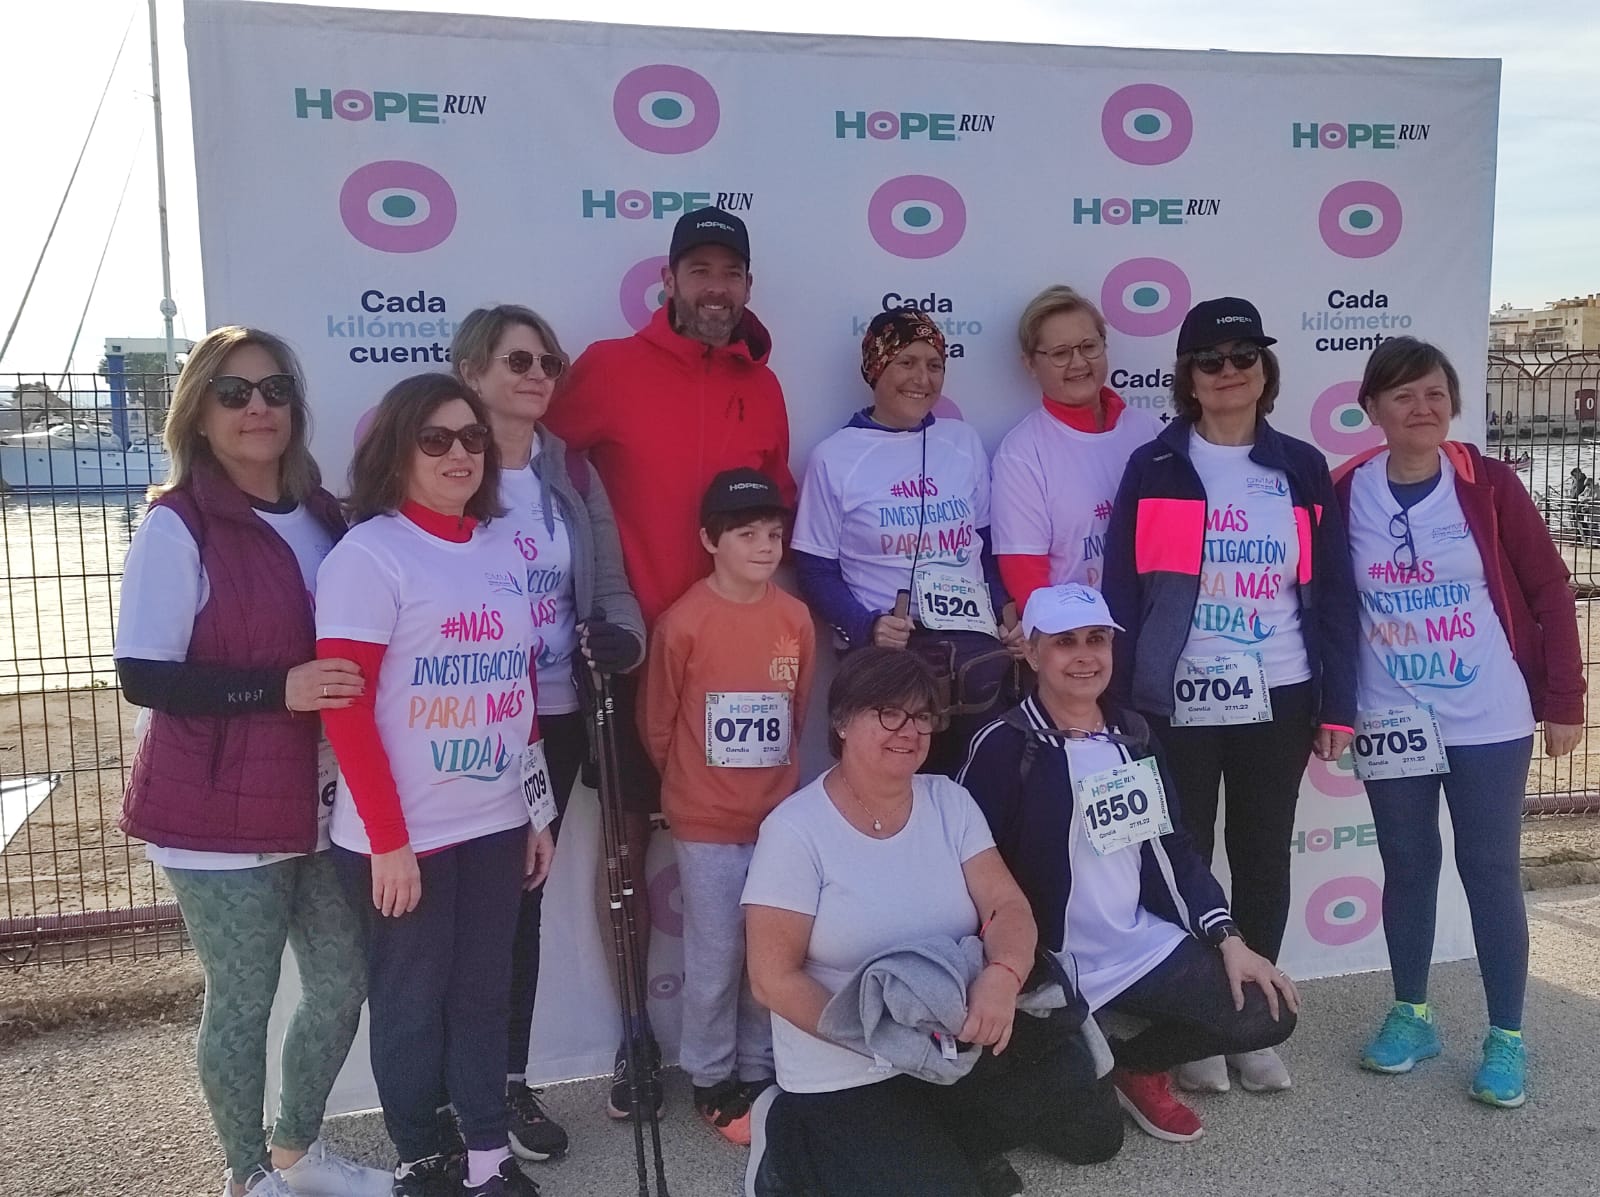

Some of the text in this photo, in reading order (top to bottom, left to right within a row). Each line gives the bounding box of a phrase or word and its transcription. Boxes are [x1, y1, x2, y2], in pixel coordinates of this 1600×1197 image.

[295, 88, 486, 124] HOPE RUN
[835, 111, 995, 141] HOPE RUN
[1292, 122, 1430, 149] HOPE RUN
[716, 192, 753, 211] RUN
[1073, 198, 1221, 225] HOPE RUN
[696, 220, 727, 231] HOPE
[361, 290, 446, 313] Cada
[882, 292, 953, 313] Cada
[1327, 289, 1388, 309] Cada
[1216, 316, 1246, 324] HOPE
[1301, 311, 1413, 331] kilómetro
[1315, 333, 1396, 352] cuent
[1110, 368, 1176, 389] Cada
[729, 482, 760, 492] HOPE
[890, 473, 938, 499] #MÁS
[878, 494, 971, 528] INVESTIGACIÓN
[880, 520, 972, 556] PARA MÁS
[933, 581, 968, 595] HOPE
[1235, 566, 1282, 600] MÁS
[924, 591, 980, 618] 1520
[441, 603, 504, 643] #MÁS
[1425, 606, 1476, 643] MÁS
[410, 643, 529, 686] INVESTIGACIÓN
[1187, 664, 1225, 676] HOPE
[1385, 651, 1446, 681] VIDA
[1175, 675, 1254, 703] 0704
[408, 682, 525, 730] PARA MÁS
[729, 704, 769, 714] HOPE
[714, 717, 781, 742] 0718
[1362, 718, 1400, 731] HOPE
[430, 735, 492, 773] VIDA
[1355, 728, 1428, 757] 0705
[524, 769, 547, 807] 0709
[1091, 779, 1125, 798] HOPE
[1085, 788, 1148, 830] 1550
